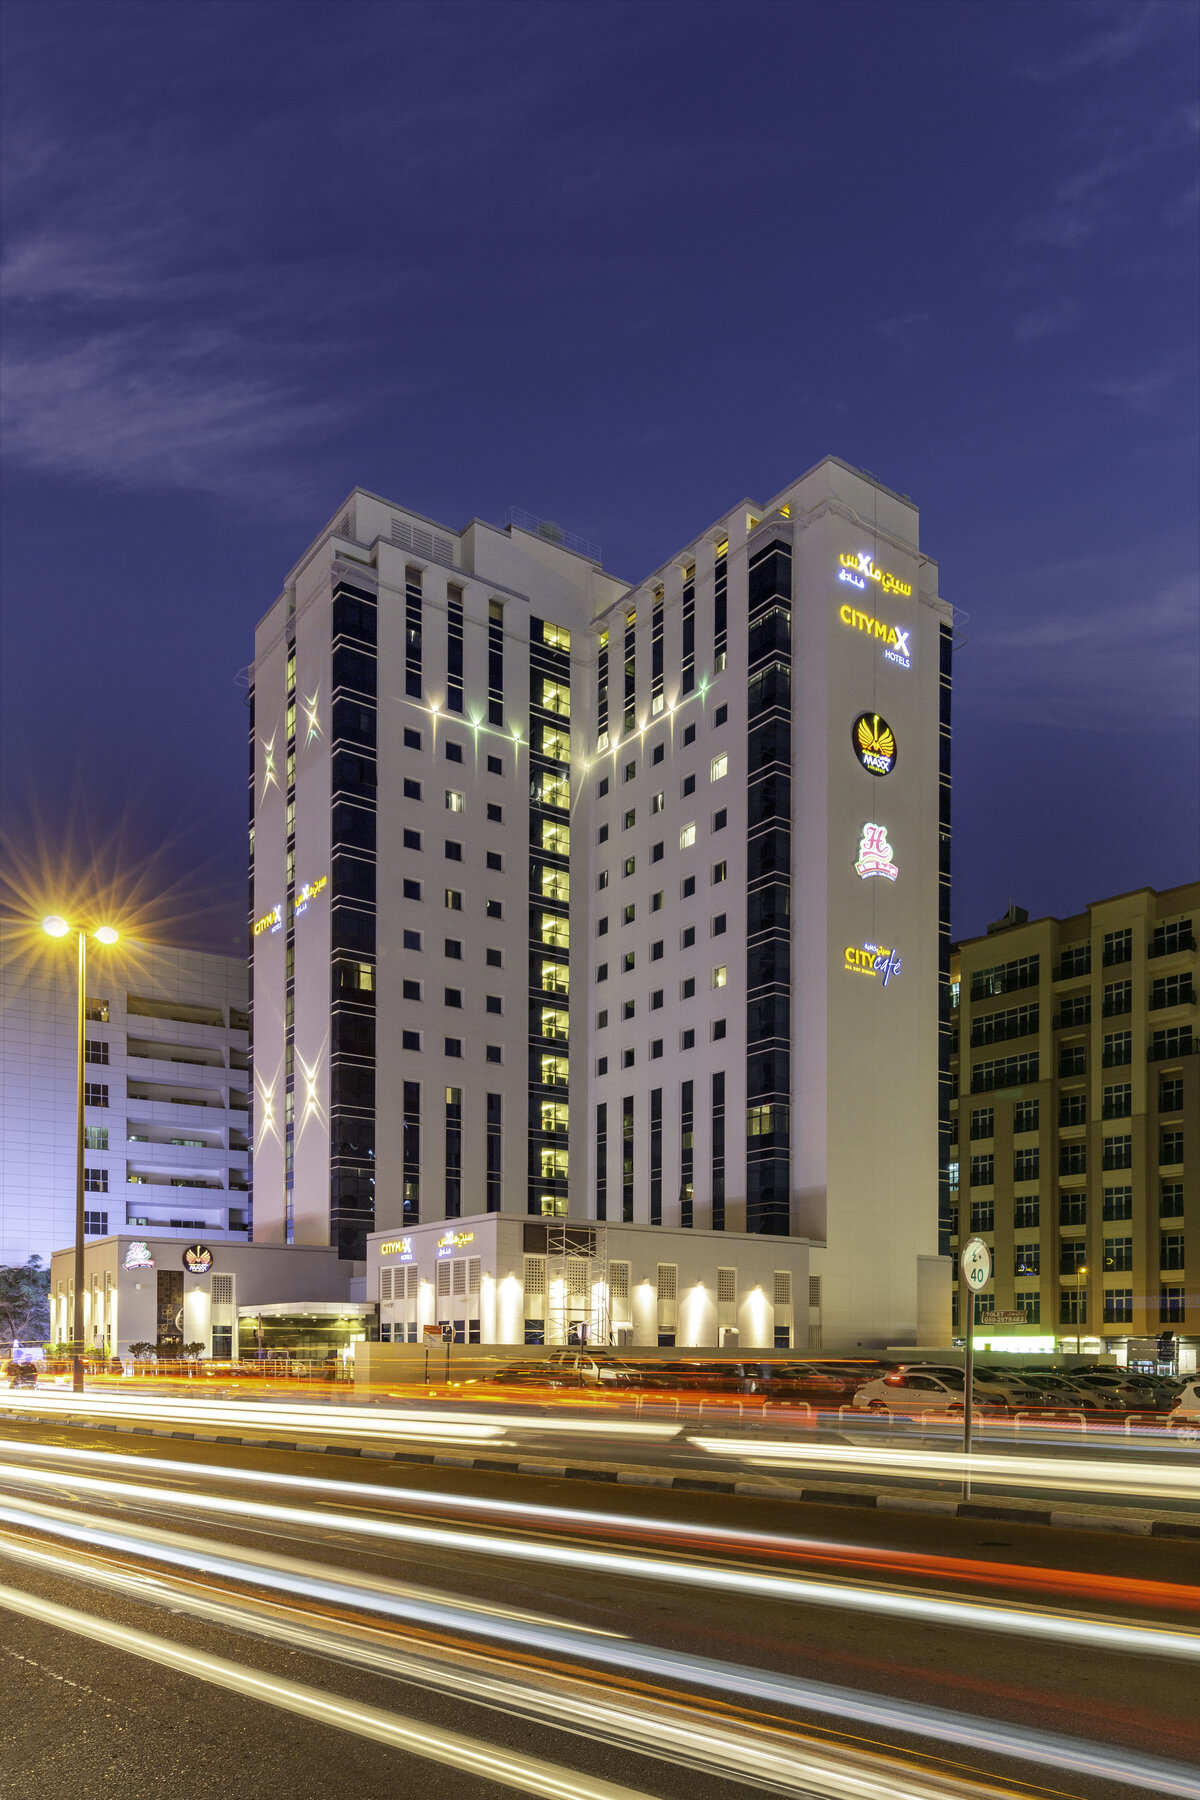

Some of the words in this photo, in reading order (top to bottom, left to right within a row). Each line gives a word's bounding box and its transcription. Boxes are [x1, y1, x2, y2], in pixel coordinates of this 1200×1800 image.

[840, 605, 910, 656] CITYMAX
[885, 649, 910, 668] HOTELS
[863, 754, 890, 772] MAXX
[381, 1237, 412, 1255] CITYMAX
[970, 1268, 984, 1283] 40
